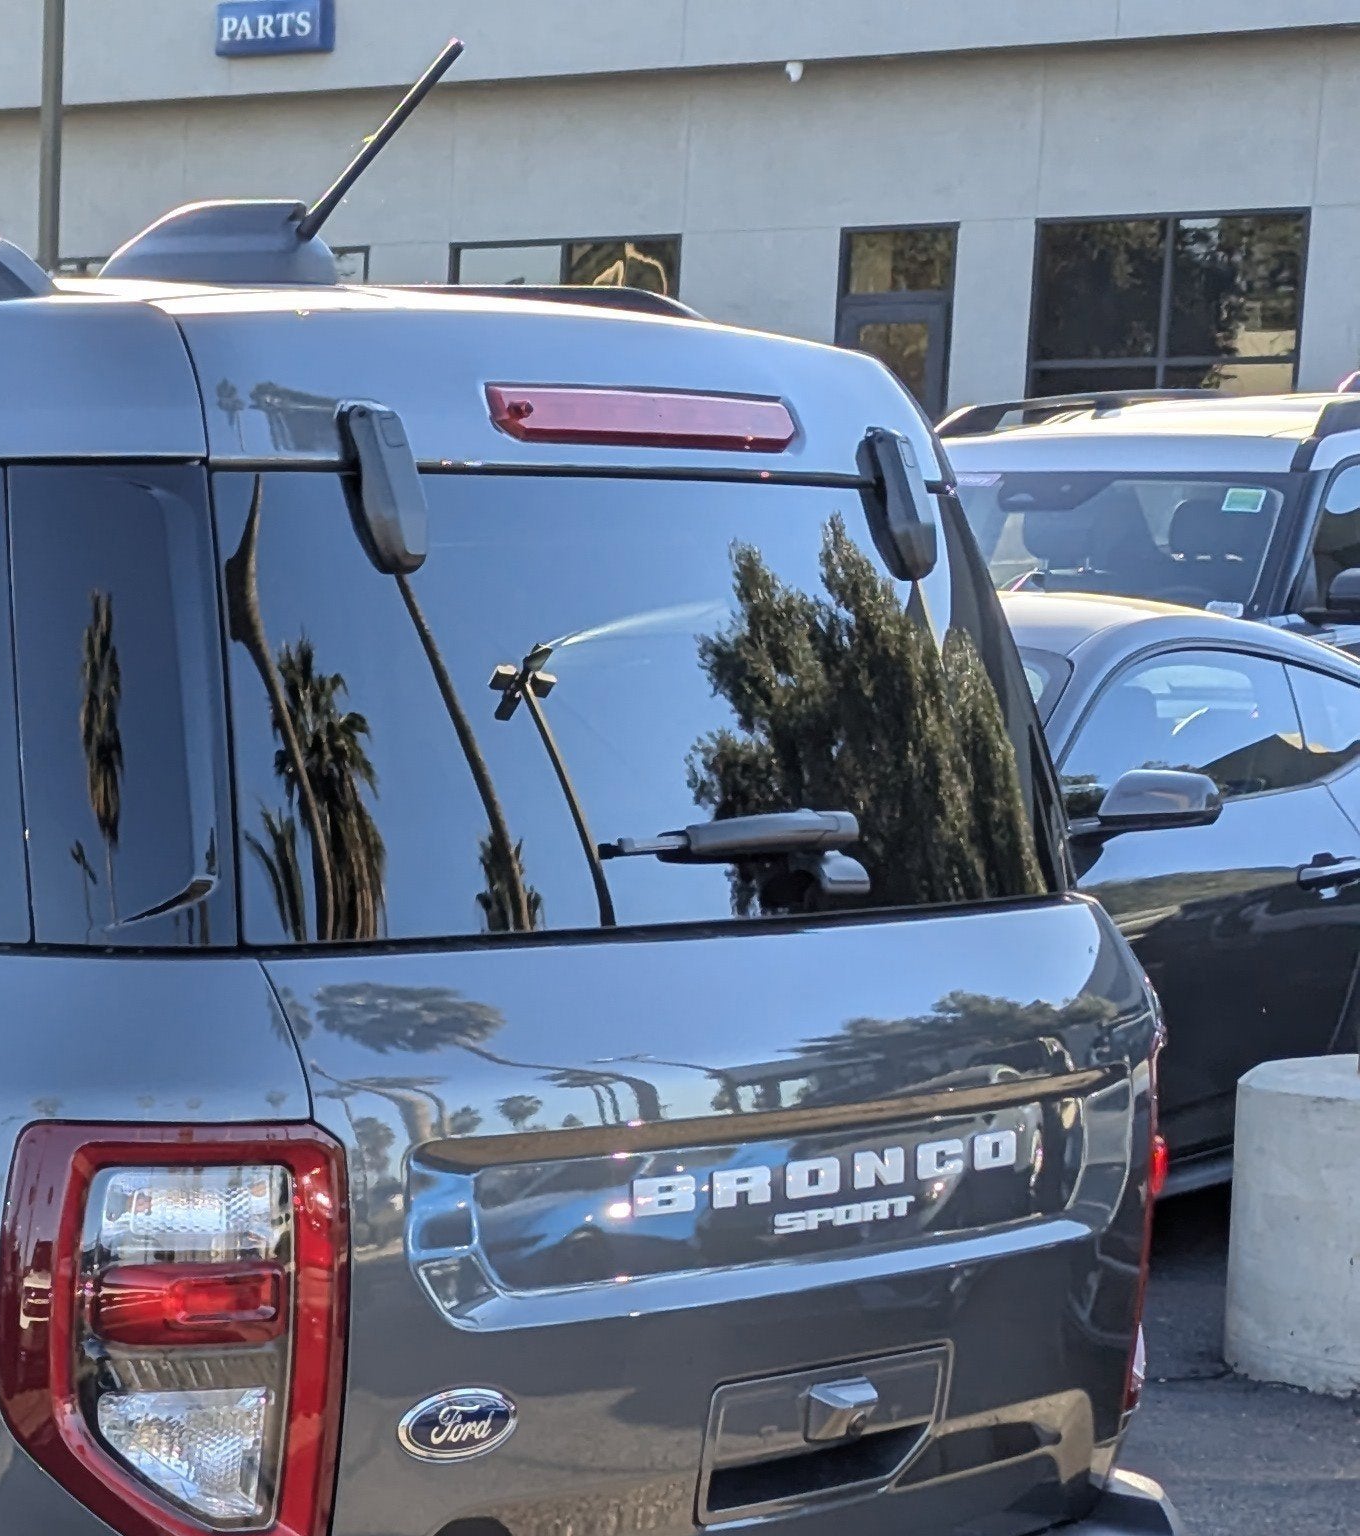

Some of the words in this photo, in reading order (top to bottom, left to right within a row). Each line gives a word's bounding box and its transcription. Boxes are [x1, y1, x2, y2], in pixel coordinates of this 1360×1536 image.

[220, 10, 312, 42] PARTS
[632, 1129, 1018, 1217] BRONCO
[774, 1196, 915, 1235] SPORT
[430, 1404, 495, 1445] Ford
